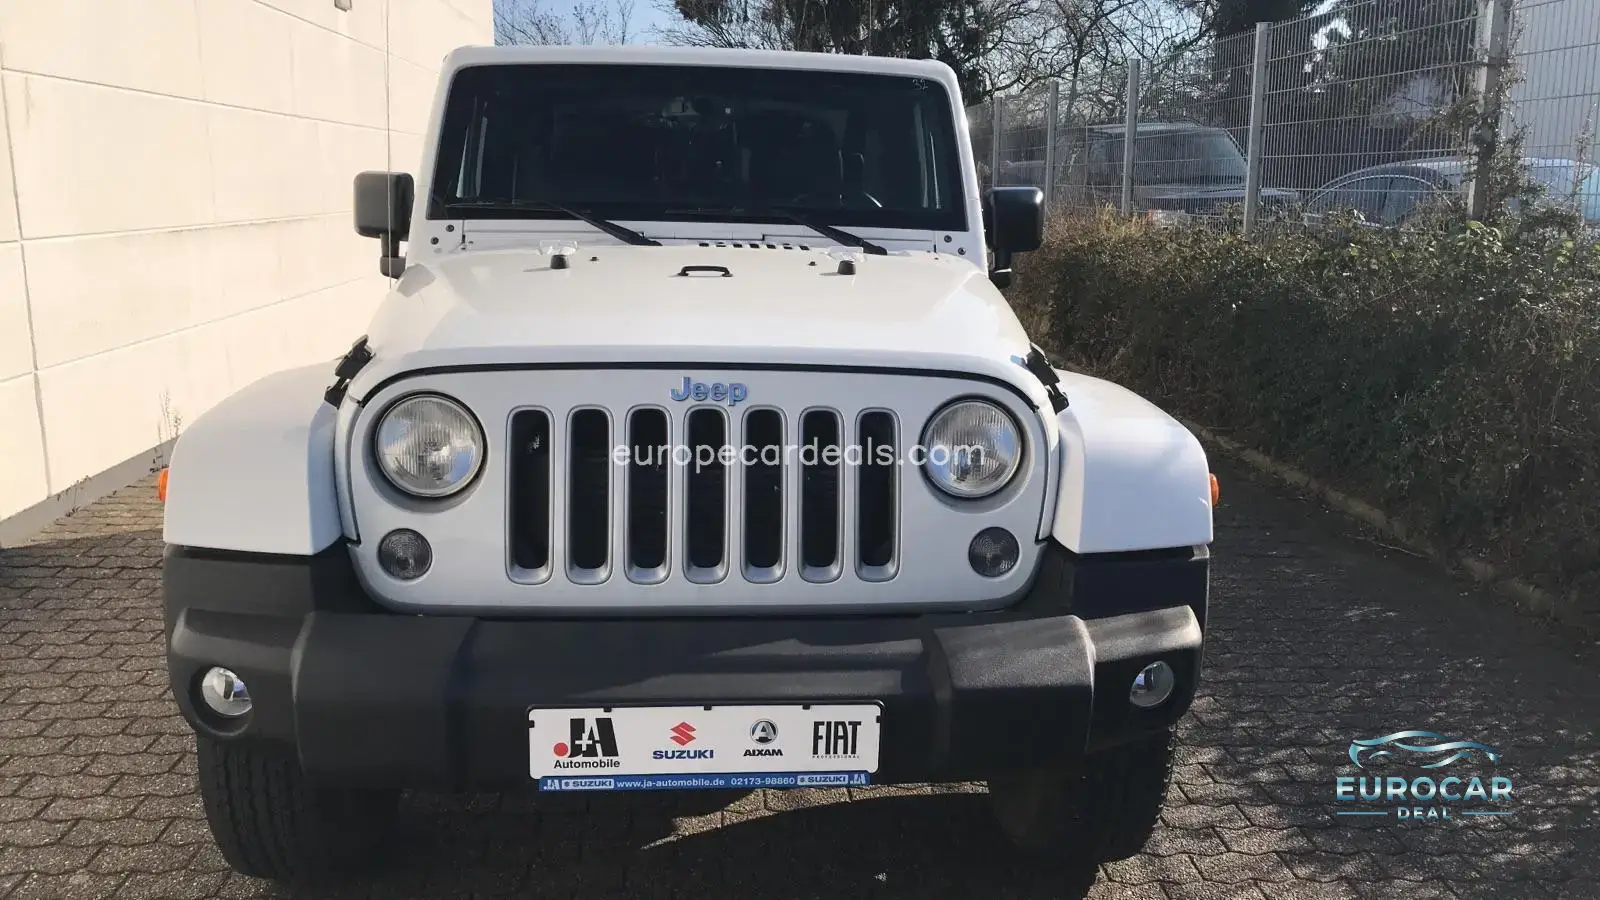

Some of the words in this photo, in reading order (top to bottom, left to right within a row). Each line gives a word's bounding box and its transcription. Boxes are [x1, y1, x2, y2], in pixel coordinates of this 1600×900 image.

[670, 376, 748, 406] Jeep
[813, 721, 861, 755] FIAT
[653, 749, 714, 760] SUZUKI
[743, 748, 783, 757] AIXAM
[554, 759, 620, 769] Automobile
[572, 779, 613, 788] SUZUKI
[617, 778, 725, 788] www.ja-automobile.de
[731, 777, 795, 786] 02173-98860
[807, 775, 846, 783] SUZUKI
